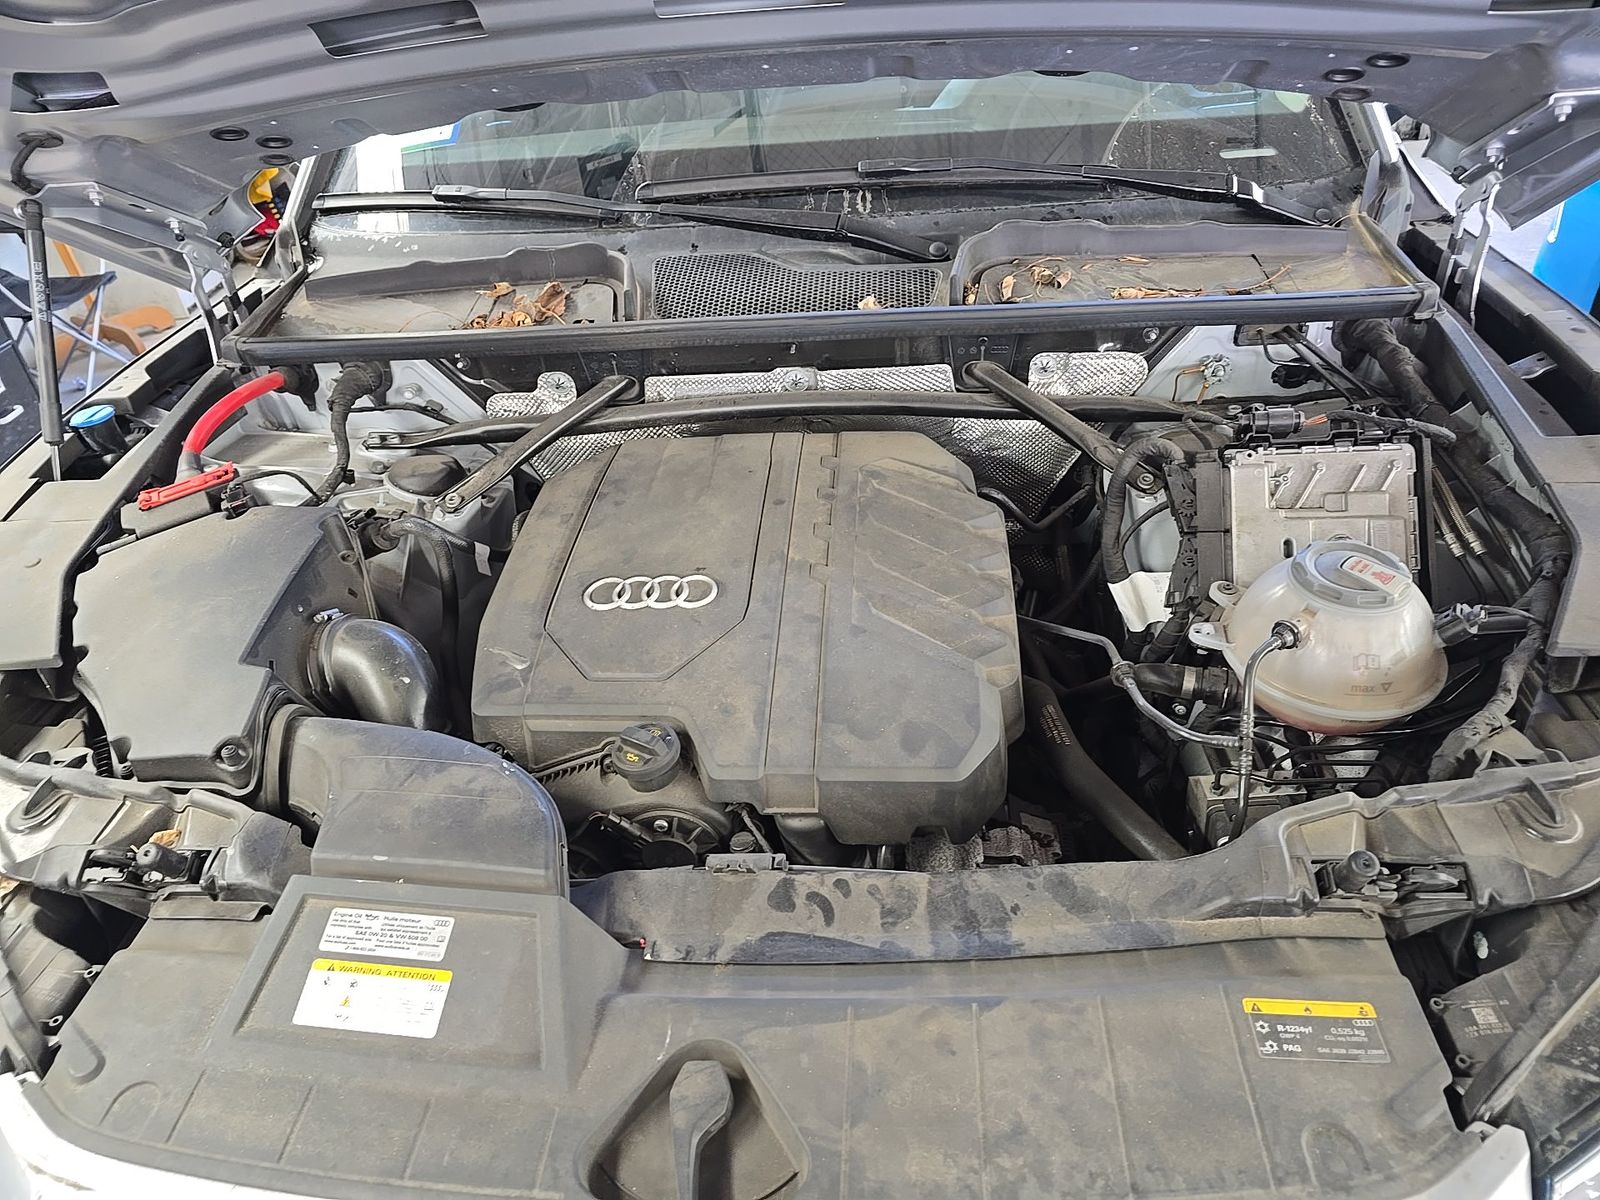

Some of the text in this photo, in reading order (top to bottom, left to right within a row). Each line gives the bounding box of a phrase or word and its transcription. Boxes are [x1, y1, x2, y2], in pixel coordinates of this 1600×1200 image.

[339, 966, 436, 981] WARNING ATTENTION
[1282, 1044, 1302, 1052] PAG
